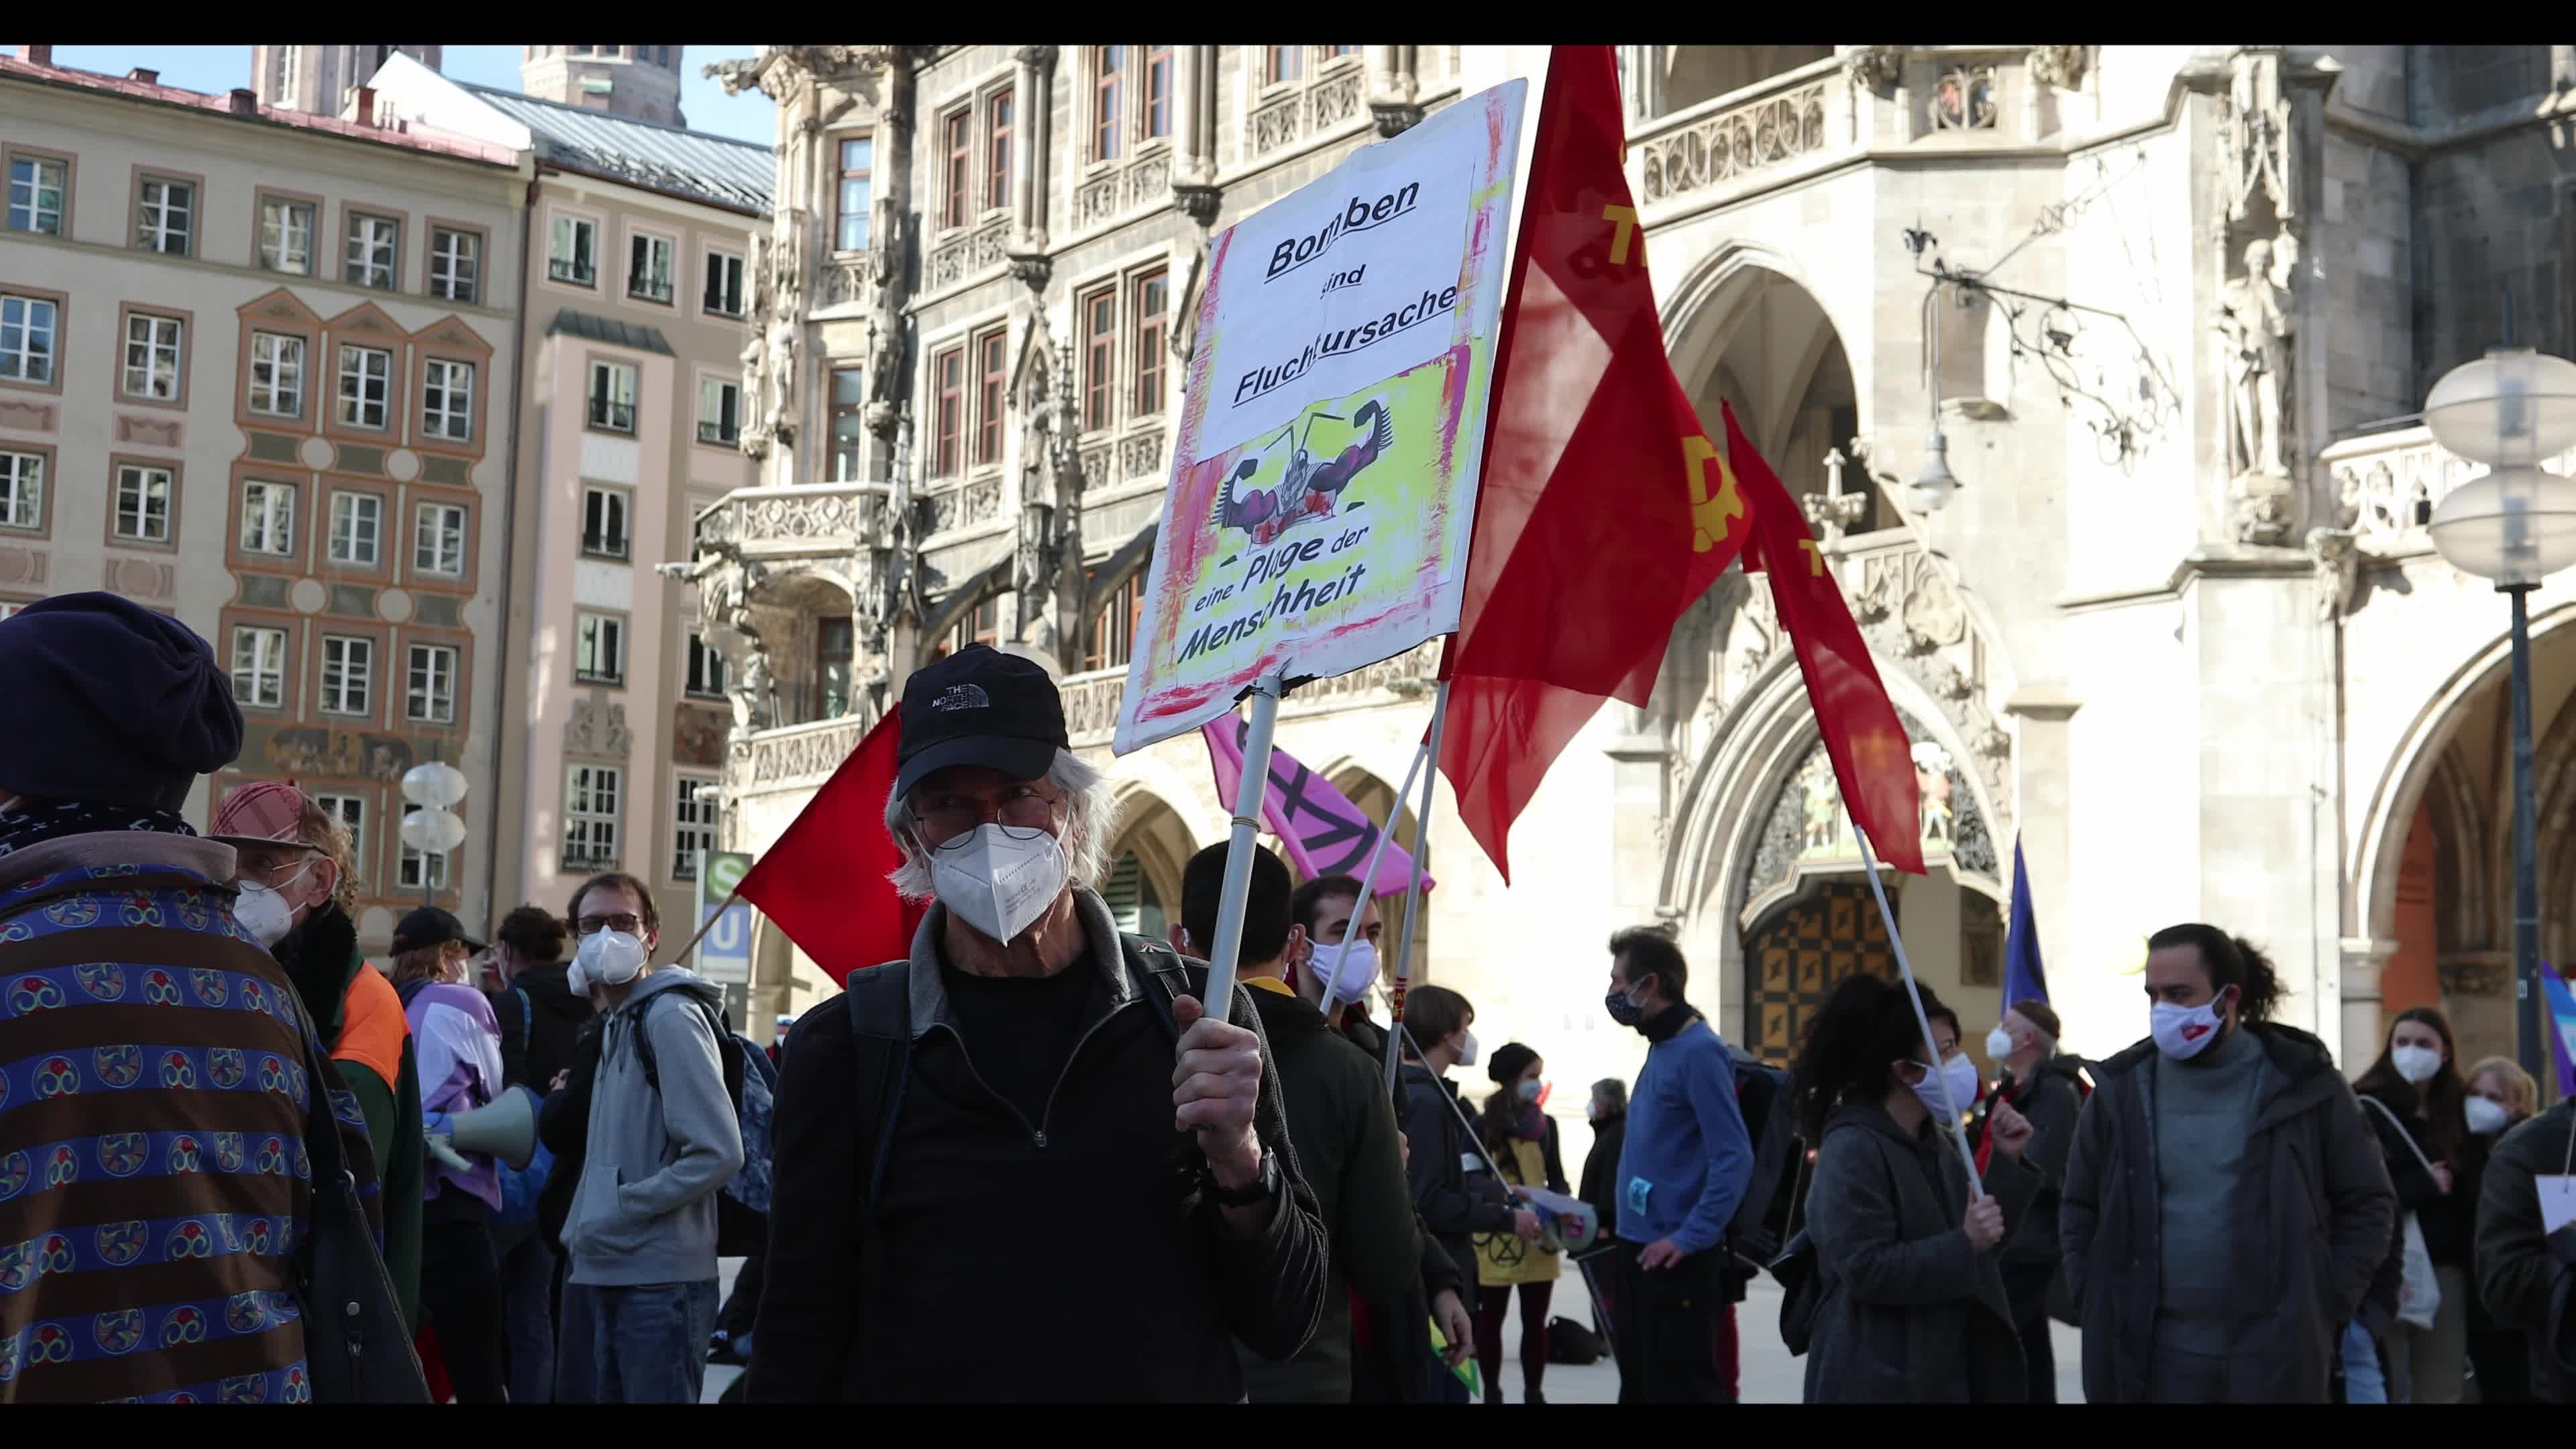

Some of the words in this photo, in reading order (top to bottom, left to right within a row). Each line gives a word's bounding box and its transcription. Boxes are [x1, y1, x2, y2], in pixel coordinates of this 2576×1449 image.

[1267, 182, 1419, 278] Bomben
[1601, 203, 1648, 268] T
[1234, 284, 1457, 403] Fluchtursache
[1194, 584, 1234, 612] eine
[1241, 537, 1324, 592] Plage
[1331, 526, 1369, 553] der
[1177, 564, 1366, 664] Menschheit
[941, 700, 969, 712] FACE
[945, 684, 968, 695] THE
[714, 857, 746, 898] S
[712, 912, 741, 950] U
